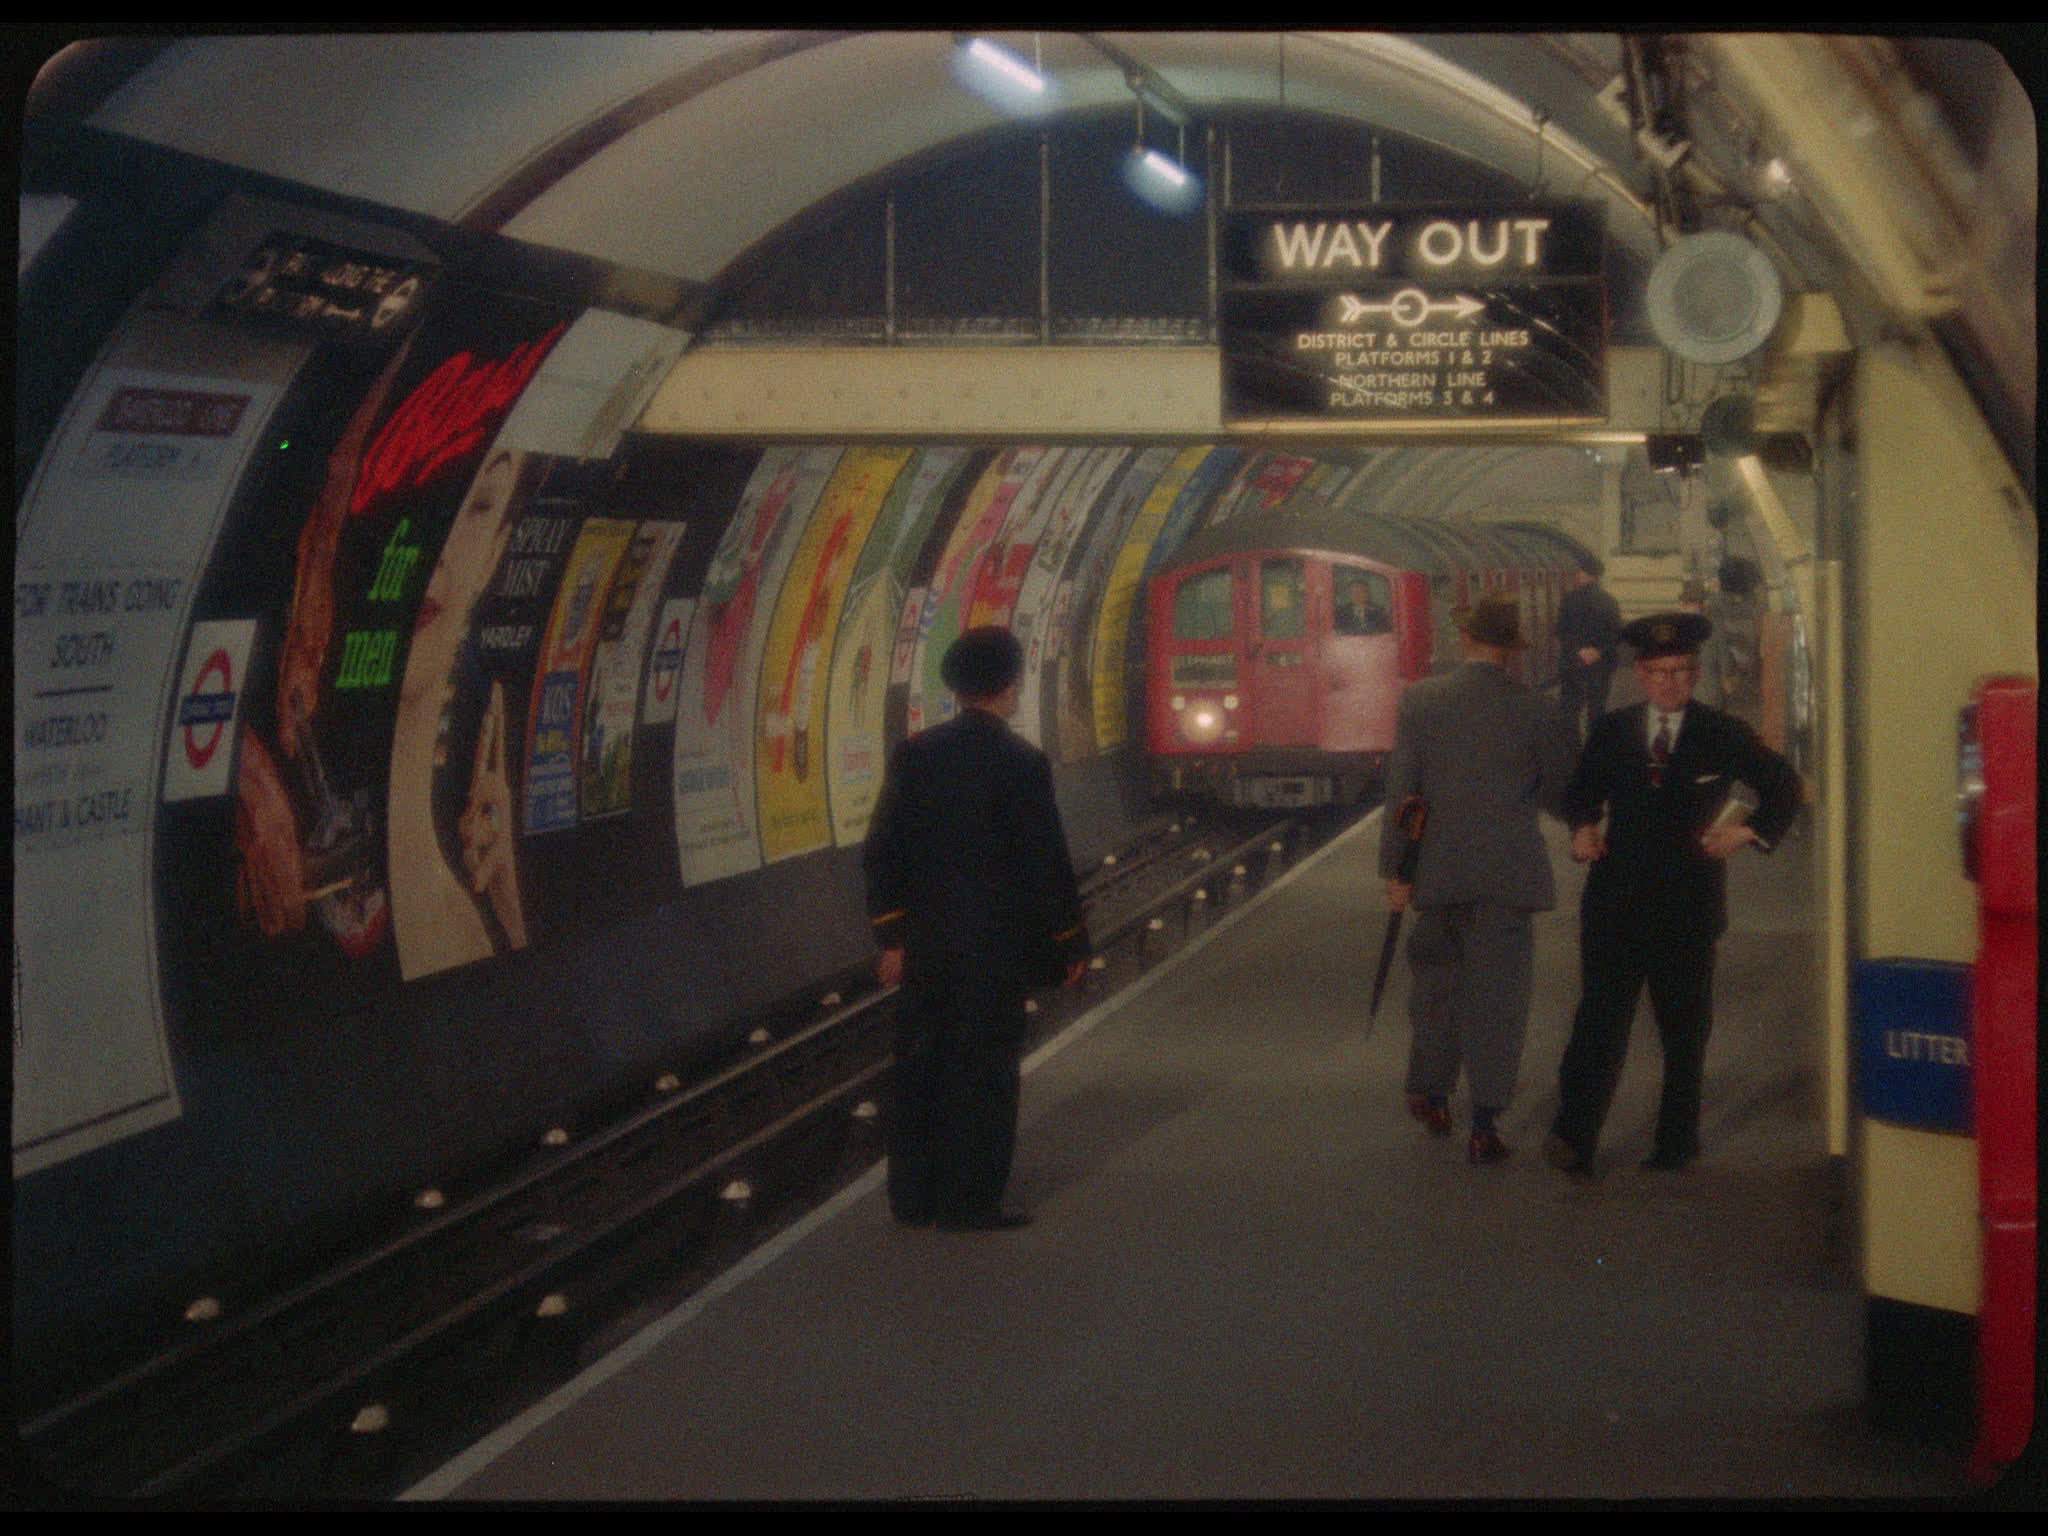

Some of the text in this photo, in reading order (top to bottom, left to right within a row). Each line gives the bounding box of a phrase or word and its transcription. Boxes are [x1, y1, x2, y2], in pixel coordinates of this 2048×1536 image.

[1273, 219, 1550, 267] WAY OUT
[1297, 330, 1529, 350] DISTRICT & CIRCLE LINES
[1335, 350, 1493, 366] PLATFORMS 1 & 2
[1339, 372, 1487, 389] NORTHERN LINE
[1330, 390, 1495, 408] PLATFORMS 3 & 4
[367, 517, 420, 600] for
[50, 631, 113, 668] SOUTH
[335, 630, 398, 688] men
[76, 788, 132, 824] CASTLE
[1885, 1029, 1972, 1067] LITTER
